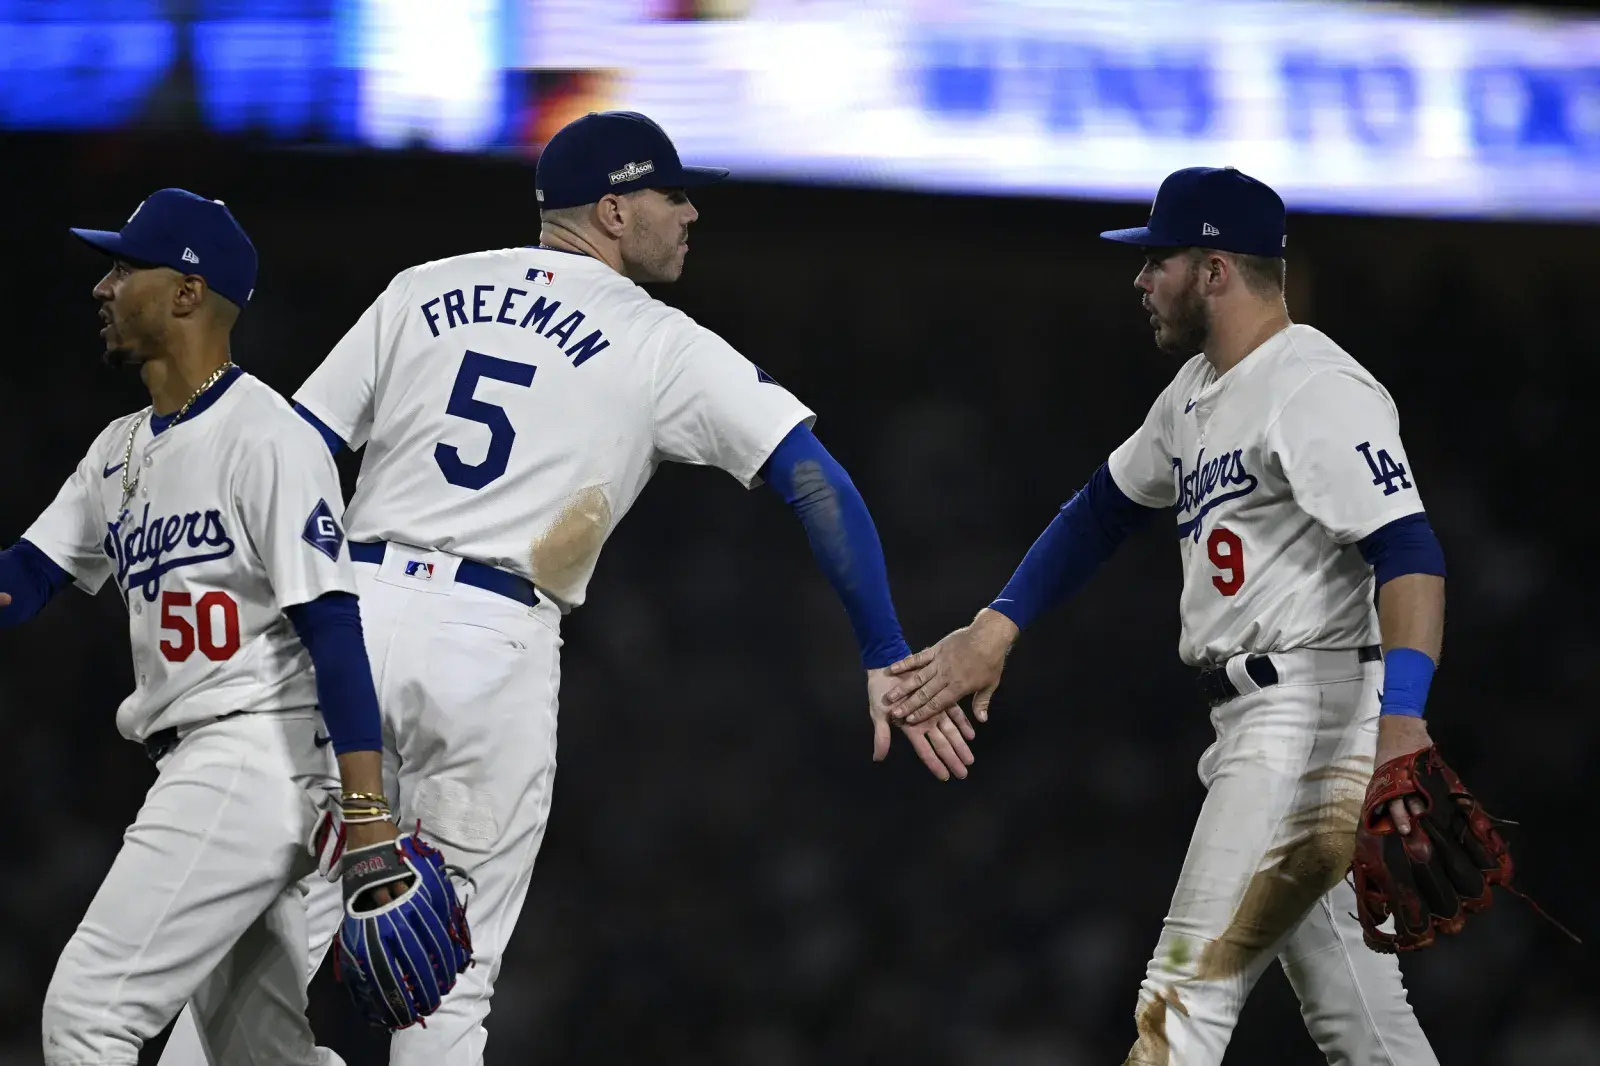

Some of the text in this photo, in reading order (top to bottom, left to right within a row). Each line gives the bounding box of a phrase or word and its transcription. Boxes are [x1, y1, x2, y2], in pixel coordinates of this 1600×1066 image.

[611, 163, 652, 182] POSTSEASON
[421, 285, 610, 368] FREEMAN
[434, 350, 537, 490] 5
[1172, 447, 1258, 544] Dodgers
[1355, 441, 1412, 496] LA
[317, 516, 336, 537] G
[1207, 528, 1245, 596] 9
[160, 591, 240, 662] 50
